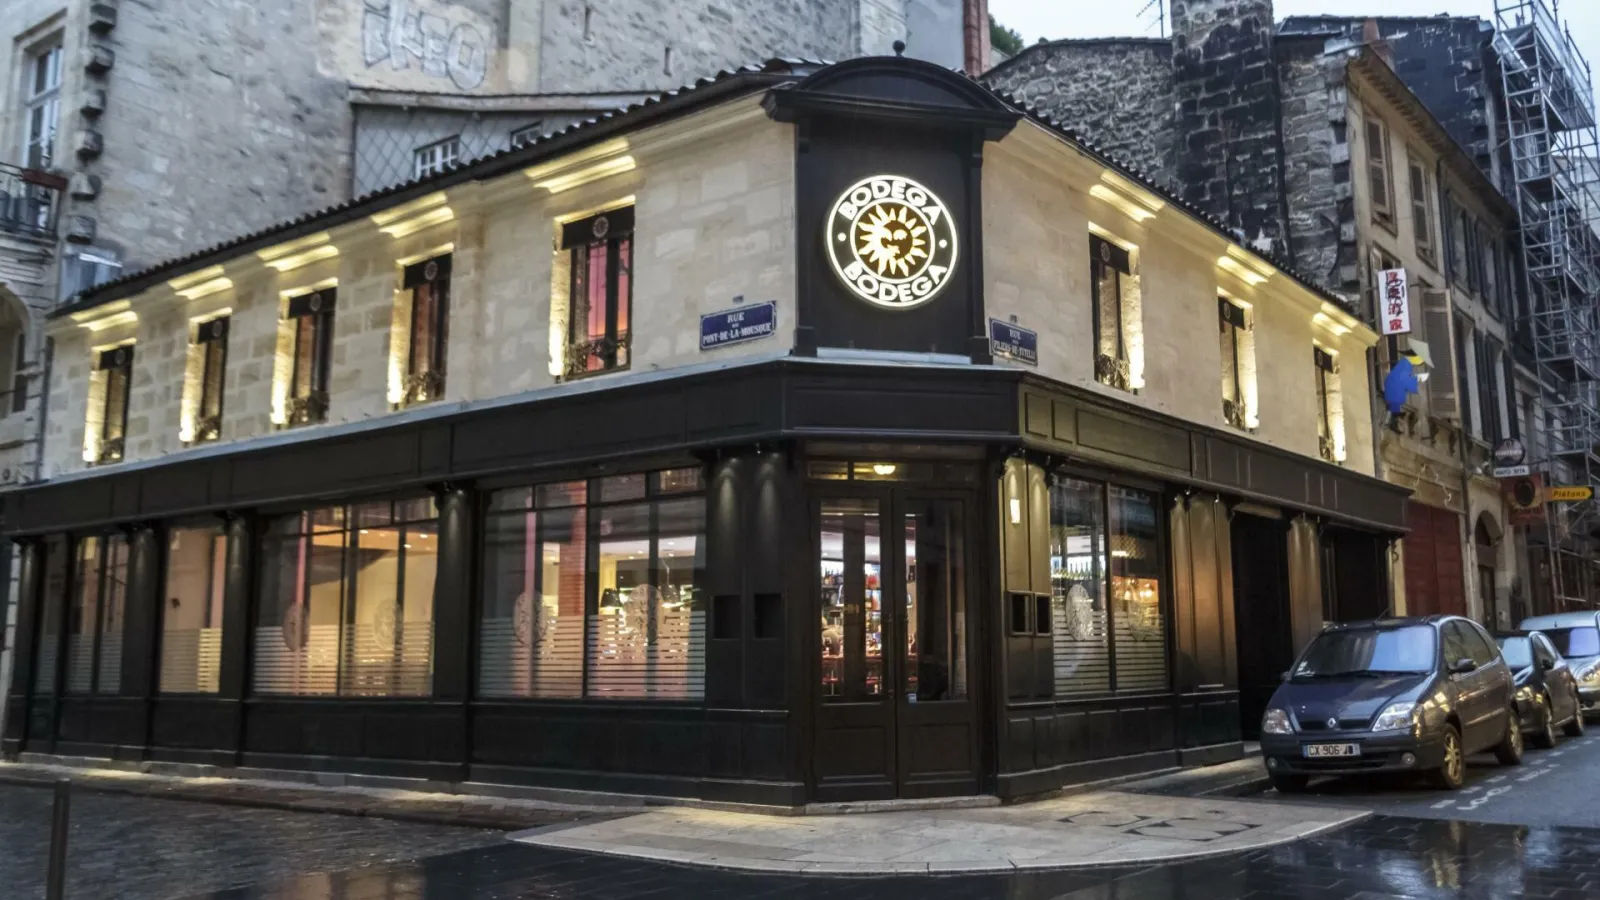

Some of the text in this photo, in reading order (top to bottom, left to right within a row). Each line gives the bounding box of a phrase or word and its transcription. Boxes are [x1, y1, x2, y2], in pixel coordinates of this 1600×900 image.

[838, 179, 942, 226] BODEGA
[843, 260, 948, 303] BODEGA
[727, 312, 745, 323] RUE
[1323, 745, 1340, 755] 906
